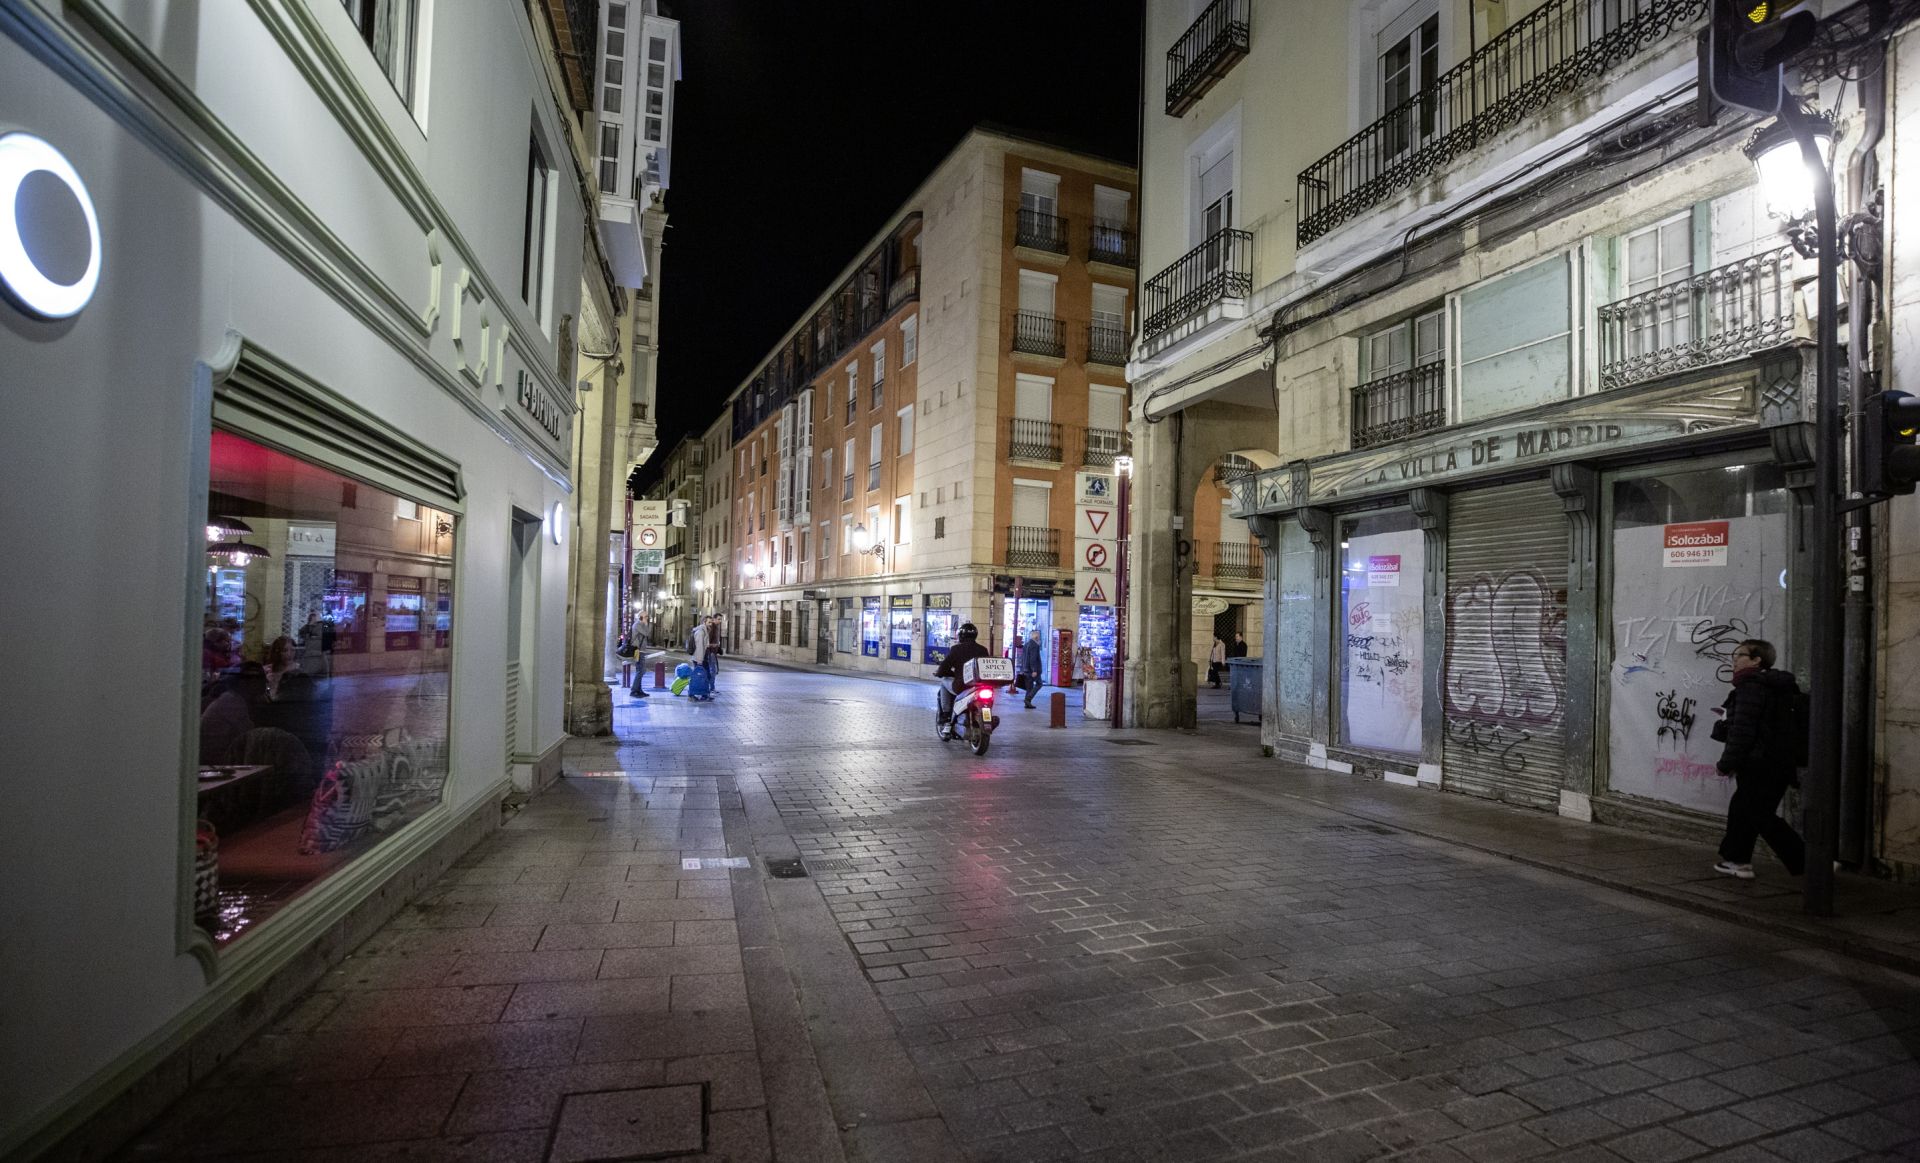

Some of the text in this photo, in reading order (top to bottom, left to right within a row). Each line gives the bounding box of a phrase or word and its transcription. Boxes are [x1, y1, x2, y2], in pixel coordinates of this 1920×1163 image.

[1399, 450, 1458, 479] VILLA
[1471, 435, 1501, 466] DE
[1671, 533, 1724, 546] Solozábal
[1702, 549, 1714, 557] 311
